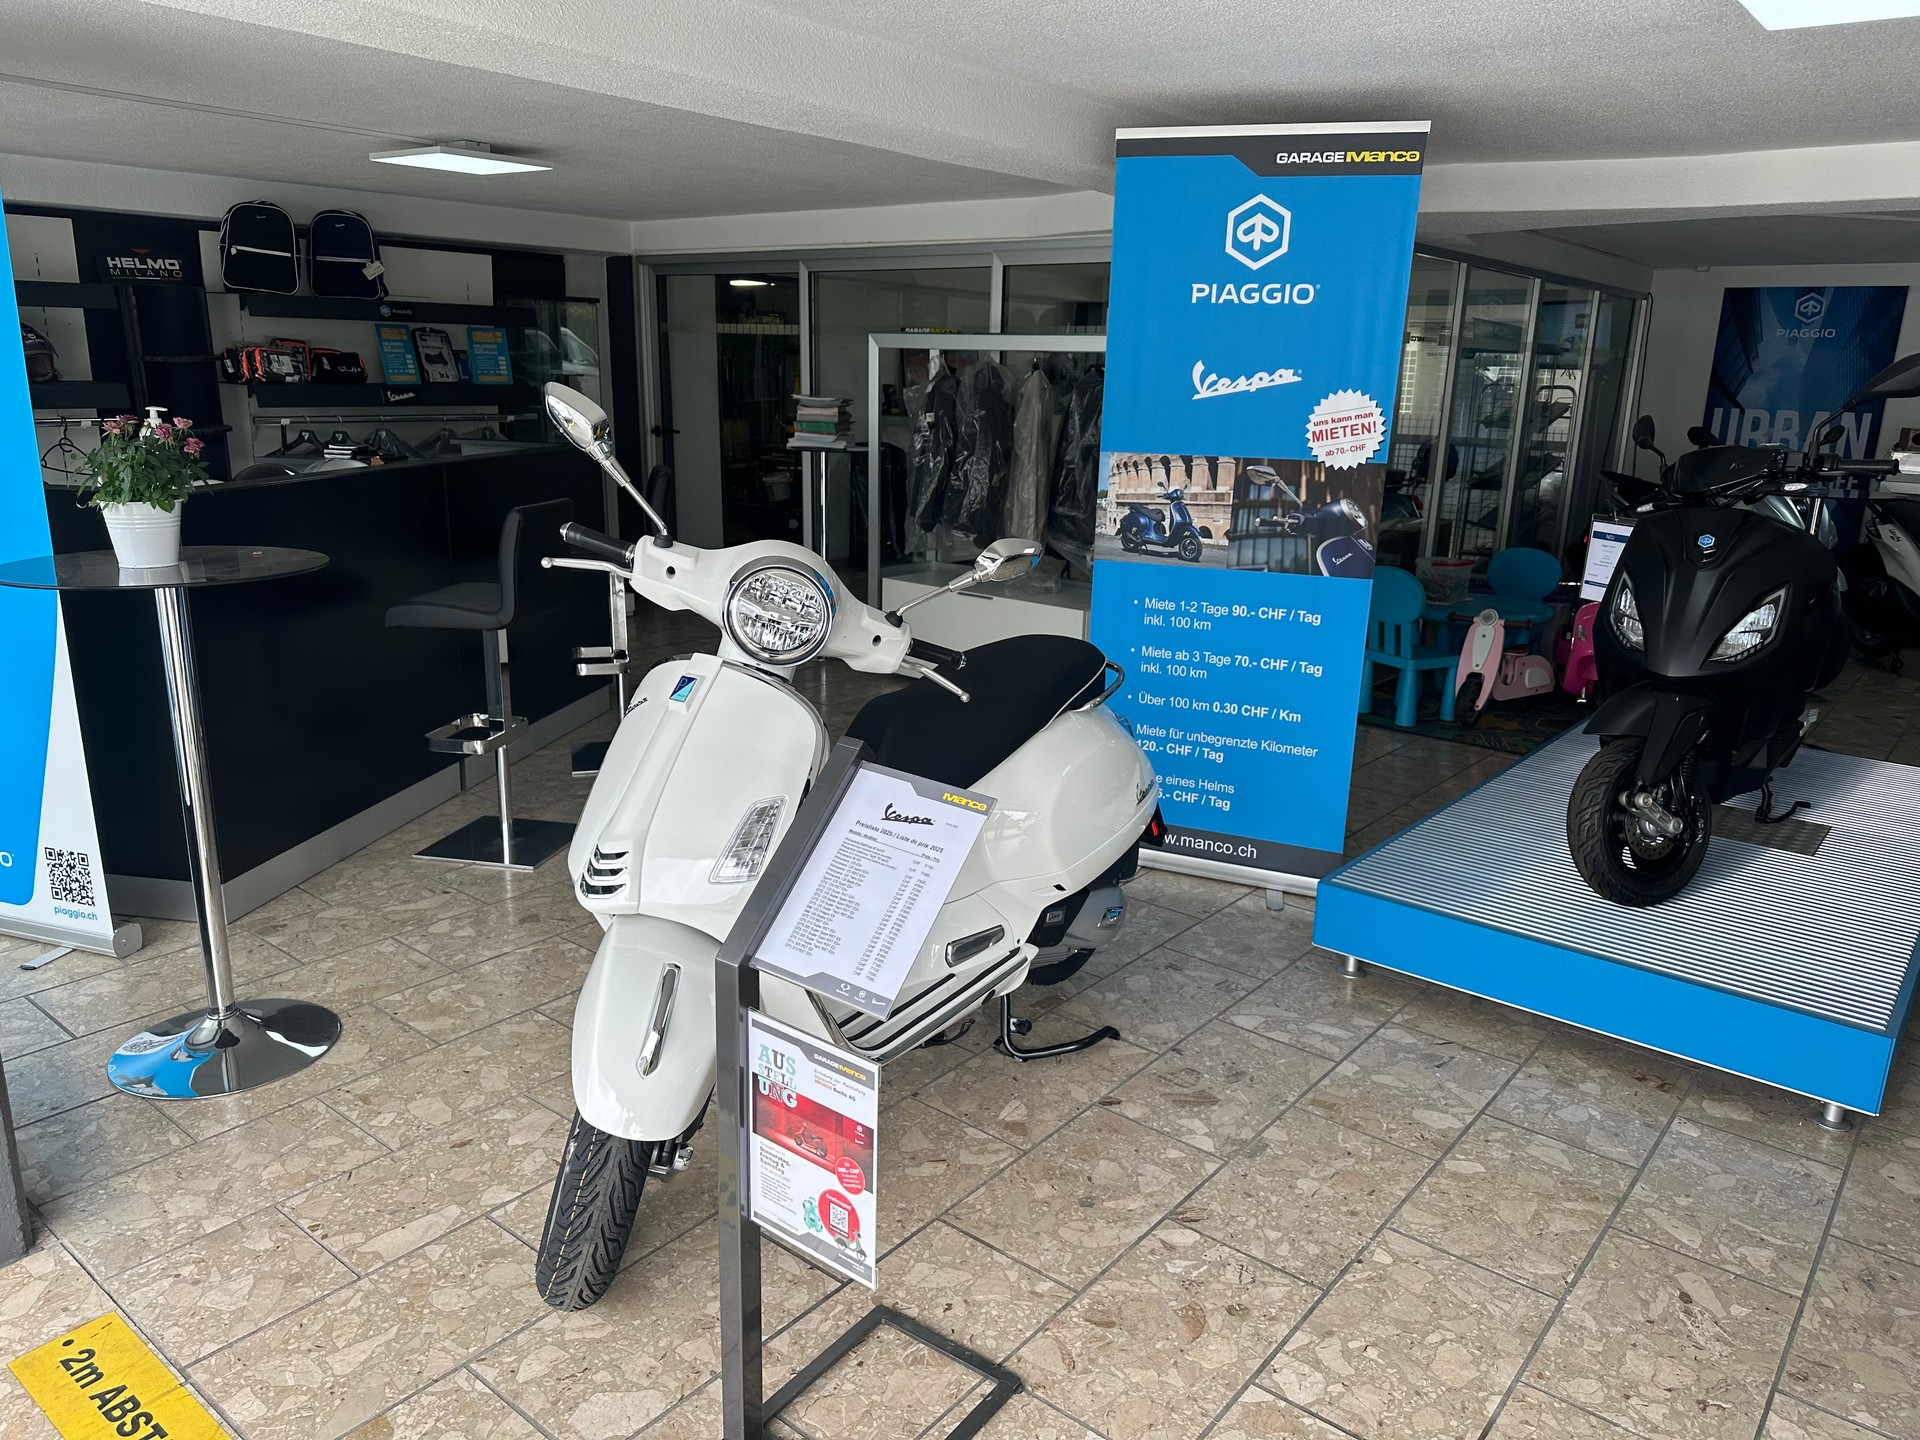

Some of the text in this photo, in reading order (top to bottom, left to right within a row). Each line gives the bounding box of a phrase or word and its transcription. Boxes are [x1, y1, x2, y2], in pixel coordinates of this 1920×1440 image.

[107, 257, 180, 270] HELMO
[110, 268, 182, 278] MILANO
[1191, 283, 1316, 304] PIAGGIO
[1776, 328, 1836, 339] PIAGGIO
[1192, 360, 1302, 400] Vespa
[387, 390, 416, 402] Vespa
[1330, 416, 1352, 424] kann
[1354, 412, 1374, 420] man
[1312, 420, 1377, 442] MIETEN!
[1350, 444, 1366, 452] CHF
[1144, 598, 1176, 611] Miete
[1179, 601, 1198, 613] 1-2
[1200, 602, 1229, 618] Tage
[1232, 605, 1256, 618] 90.-
[1258, 608, 1287, 620] CHF
[1298, 610, 1322, 626] Tag
[1144, 614, 1212, 630] inkl. 100 km
[1140, 662, 1207, 680] inkl. 100 km
[1142, 646, 1172, 659] Miete
[1174, 650, 1190, 661] ab
[1192, 651, 1200, 662] 3
[1203, 652, 1231, 667] Tage
[1234, 655, 1257, 668] 70.-
[1260, 658, 1288, 672] CHF
[1299, 662, 1322, 678] Tag
[1138, 691, 1165, 706] Über
[1169, 696, 1190, 708] 100
[1192, 698, 1210, 712] km
[1212, 702, 1238, 714] 0.30
[1241, 704, 1270, 718] CHF
[1280, 710, 1302, 722] Km
[1136, 724, 1318, 758] Miete für unbegrenzte Kilometer
[1166, 744, 1192, 757] CHF
[1202, 748, 1224, 763] Tag
[1166, 775, 1196, 788] eines
[1198, 778, 1234, 794] Helms
[1173, 791, 1199, 804] CHF
[1209, 796, 1230, 811] Tag
[880, 803, 934, 826] Vespa
[855, 820, 880, 833] Preisliste
[880, 828, 893, 837] 2025
[896, 833, 910, 842] Liste
[917, 840, 929, 850] prix
[930, 844, 944, 854] 2025
[1164, 833, 1257, 859] w.manco.ch
[54, 906, 98, 921] piaggio.ch
[758, 1044, 796, 1076] AUS
[758, 1075, 798, 1108] UNG
[59, 1348, 104, 1390] 2m
